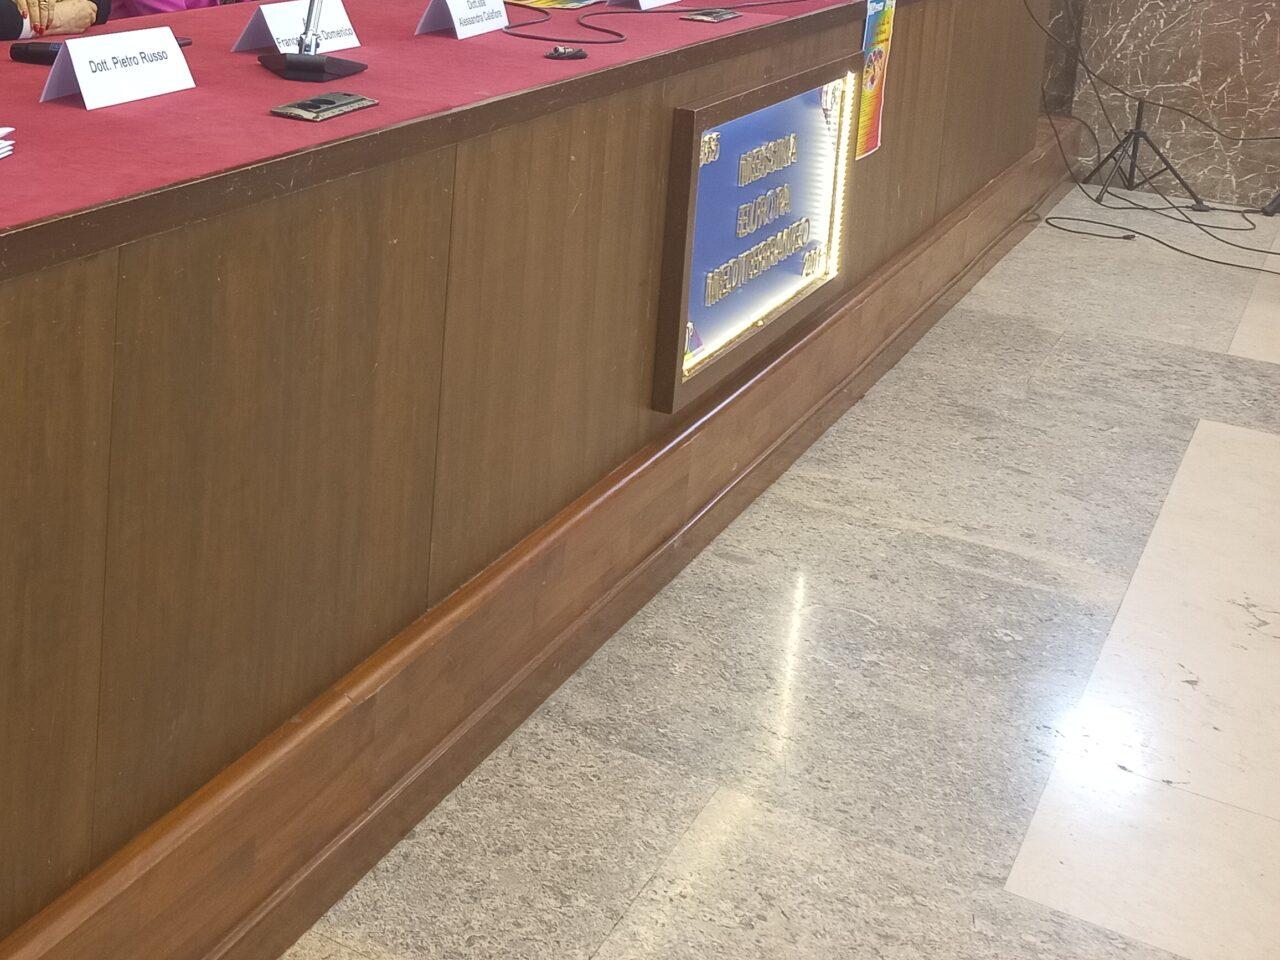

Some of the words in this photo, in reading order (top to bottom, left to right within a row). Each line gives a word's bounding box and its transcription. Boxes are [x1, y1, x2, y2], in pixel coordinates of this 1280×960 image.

[88, 58, 112, 74] Dott.
[111, 54, 139, 70] Pietro
[139, 50, 169, 65] Russo
[738, 132, 797, 187] MESSINA
[735, 183, 791, 238] EUROPA
[704, 216, 811, 307] MEDITERRANEO
